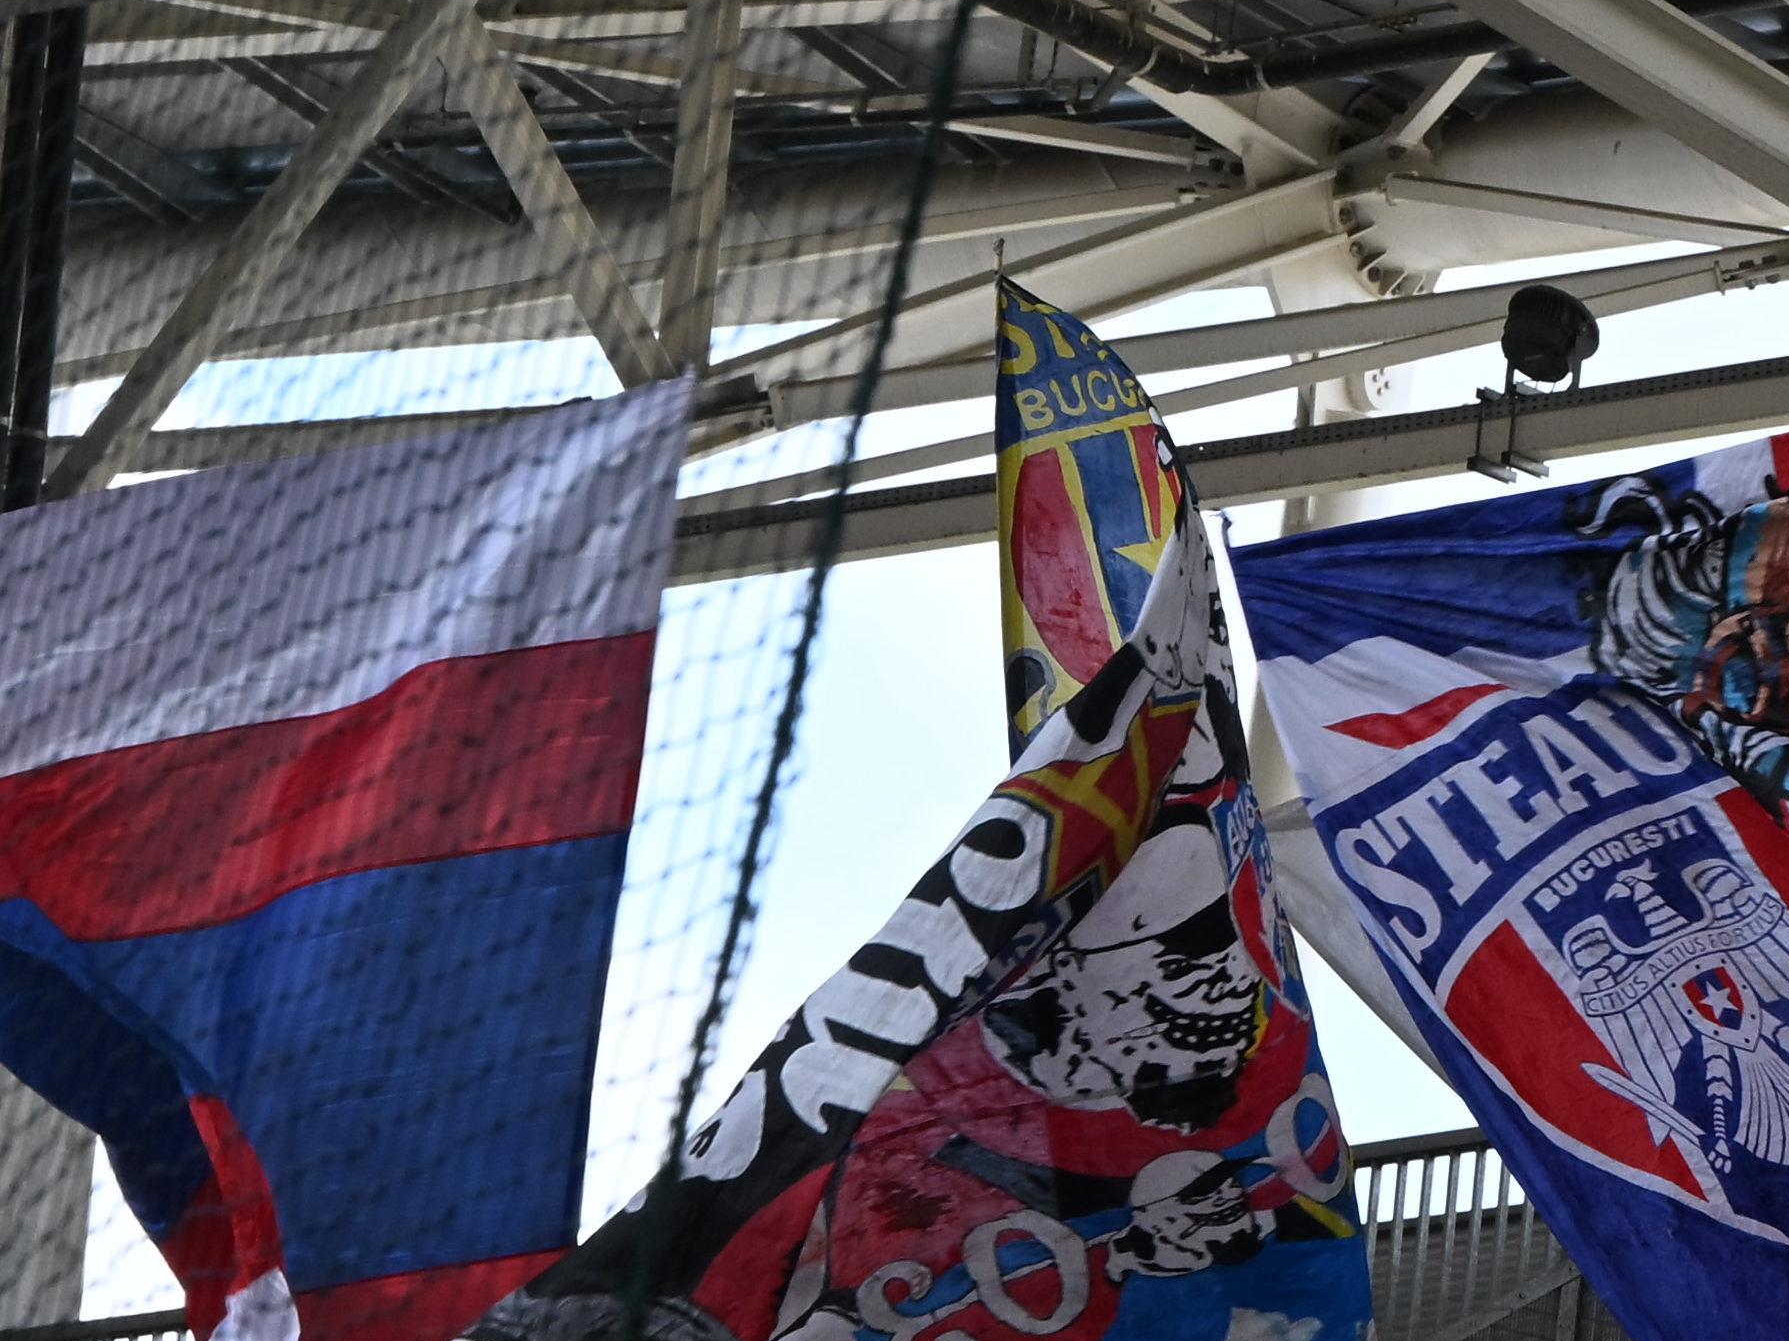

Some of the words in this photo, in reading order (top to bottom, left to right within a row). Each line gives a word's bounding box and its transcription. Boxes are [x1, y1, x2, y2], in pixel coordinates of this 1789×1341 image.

[1533, 813, 1698, 914] BUCURESTI
[1585, 973, 1649, 1013] CITIUS
[1648, 936, 1708, 980] ALTIUS
[1708, 899, 1781, 949] FORTIUS
